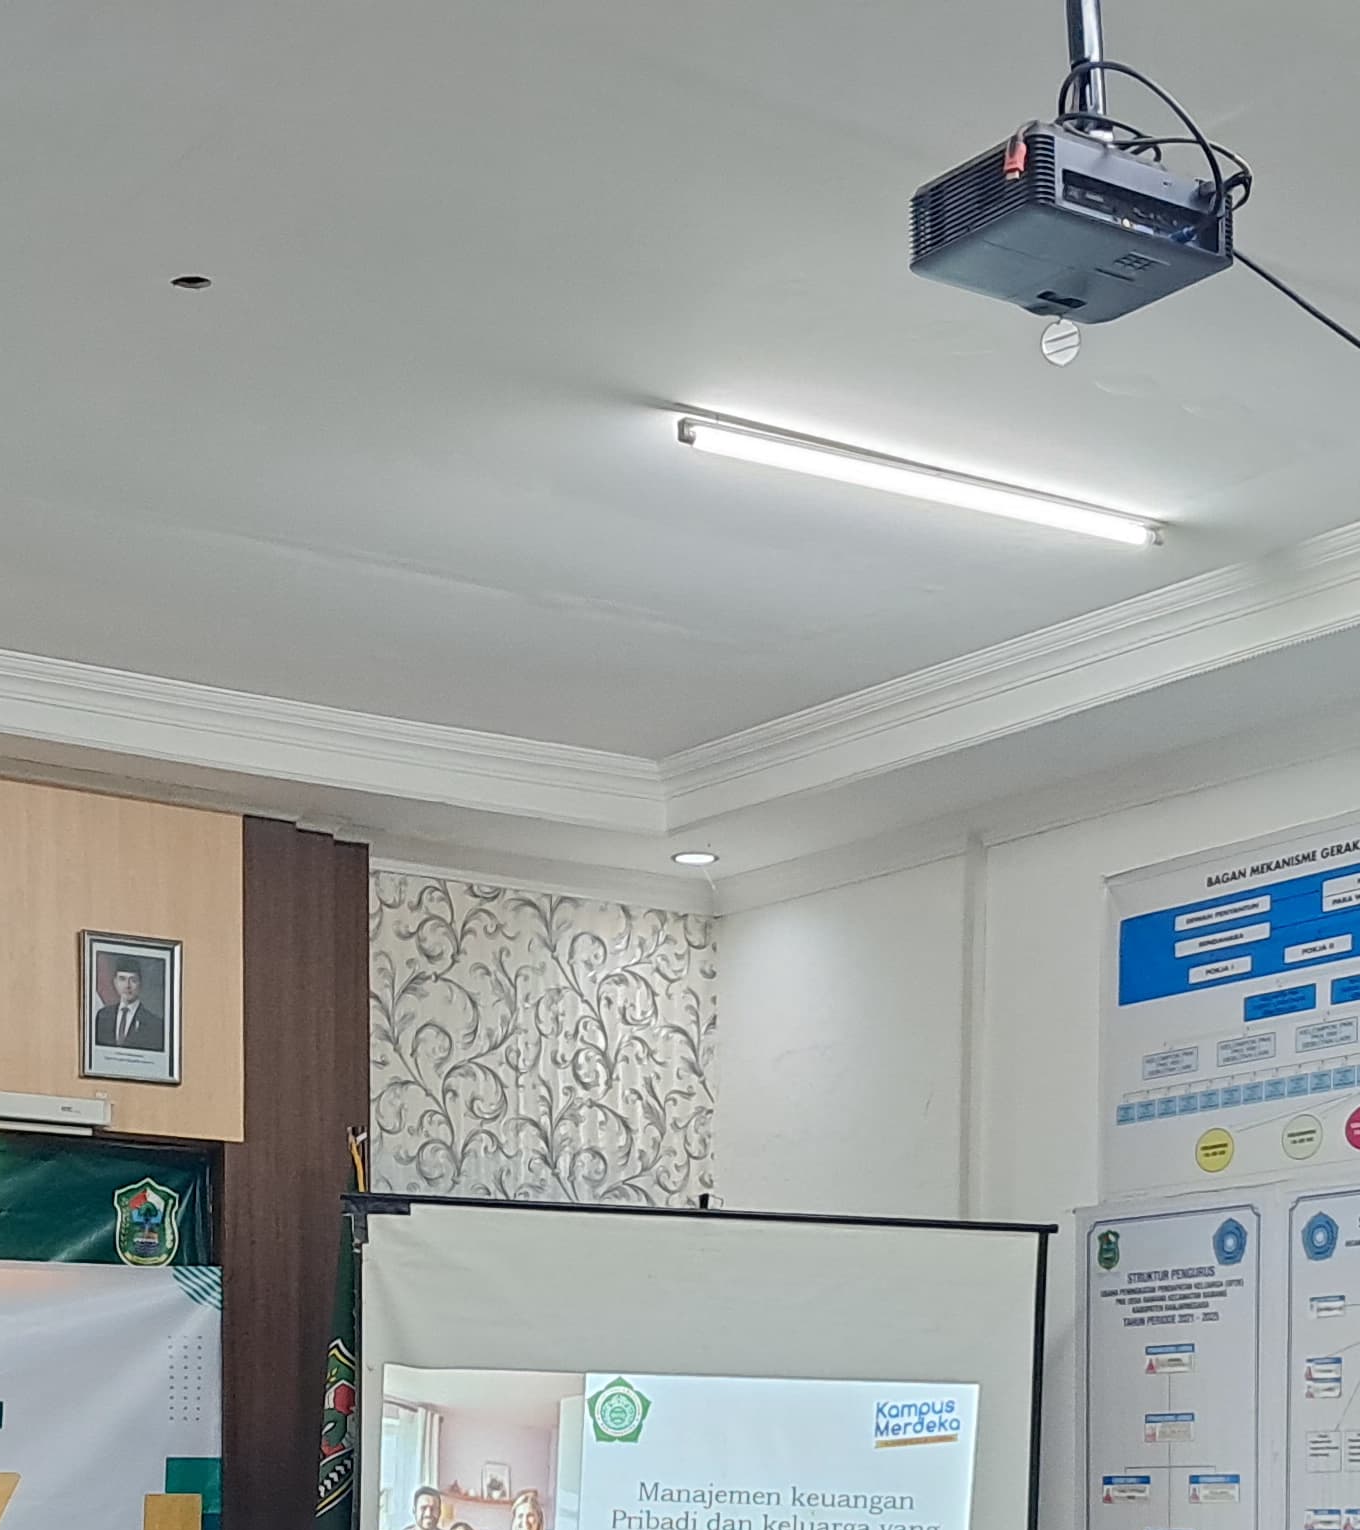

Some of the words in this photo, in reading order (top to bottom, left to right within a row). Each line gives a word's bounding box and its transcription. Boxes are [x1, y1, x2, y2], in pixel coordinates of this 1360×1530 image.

[1206, 868, 1247, 887] BAGAN
[1249, 850, 1317, 877] MEKANISME
[876, 1400, 955, 1420] Kampus
[875, 1416, 960, 1437] Merdeka
[638, 1482, 781, 1509] Manajemen
[791, 1486, 915, 1515] keuangan
[611, 1509, 697, 1530] Pribadi
